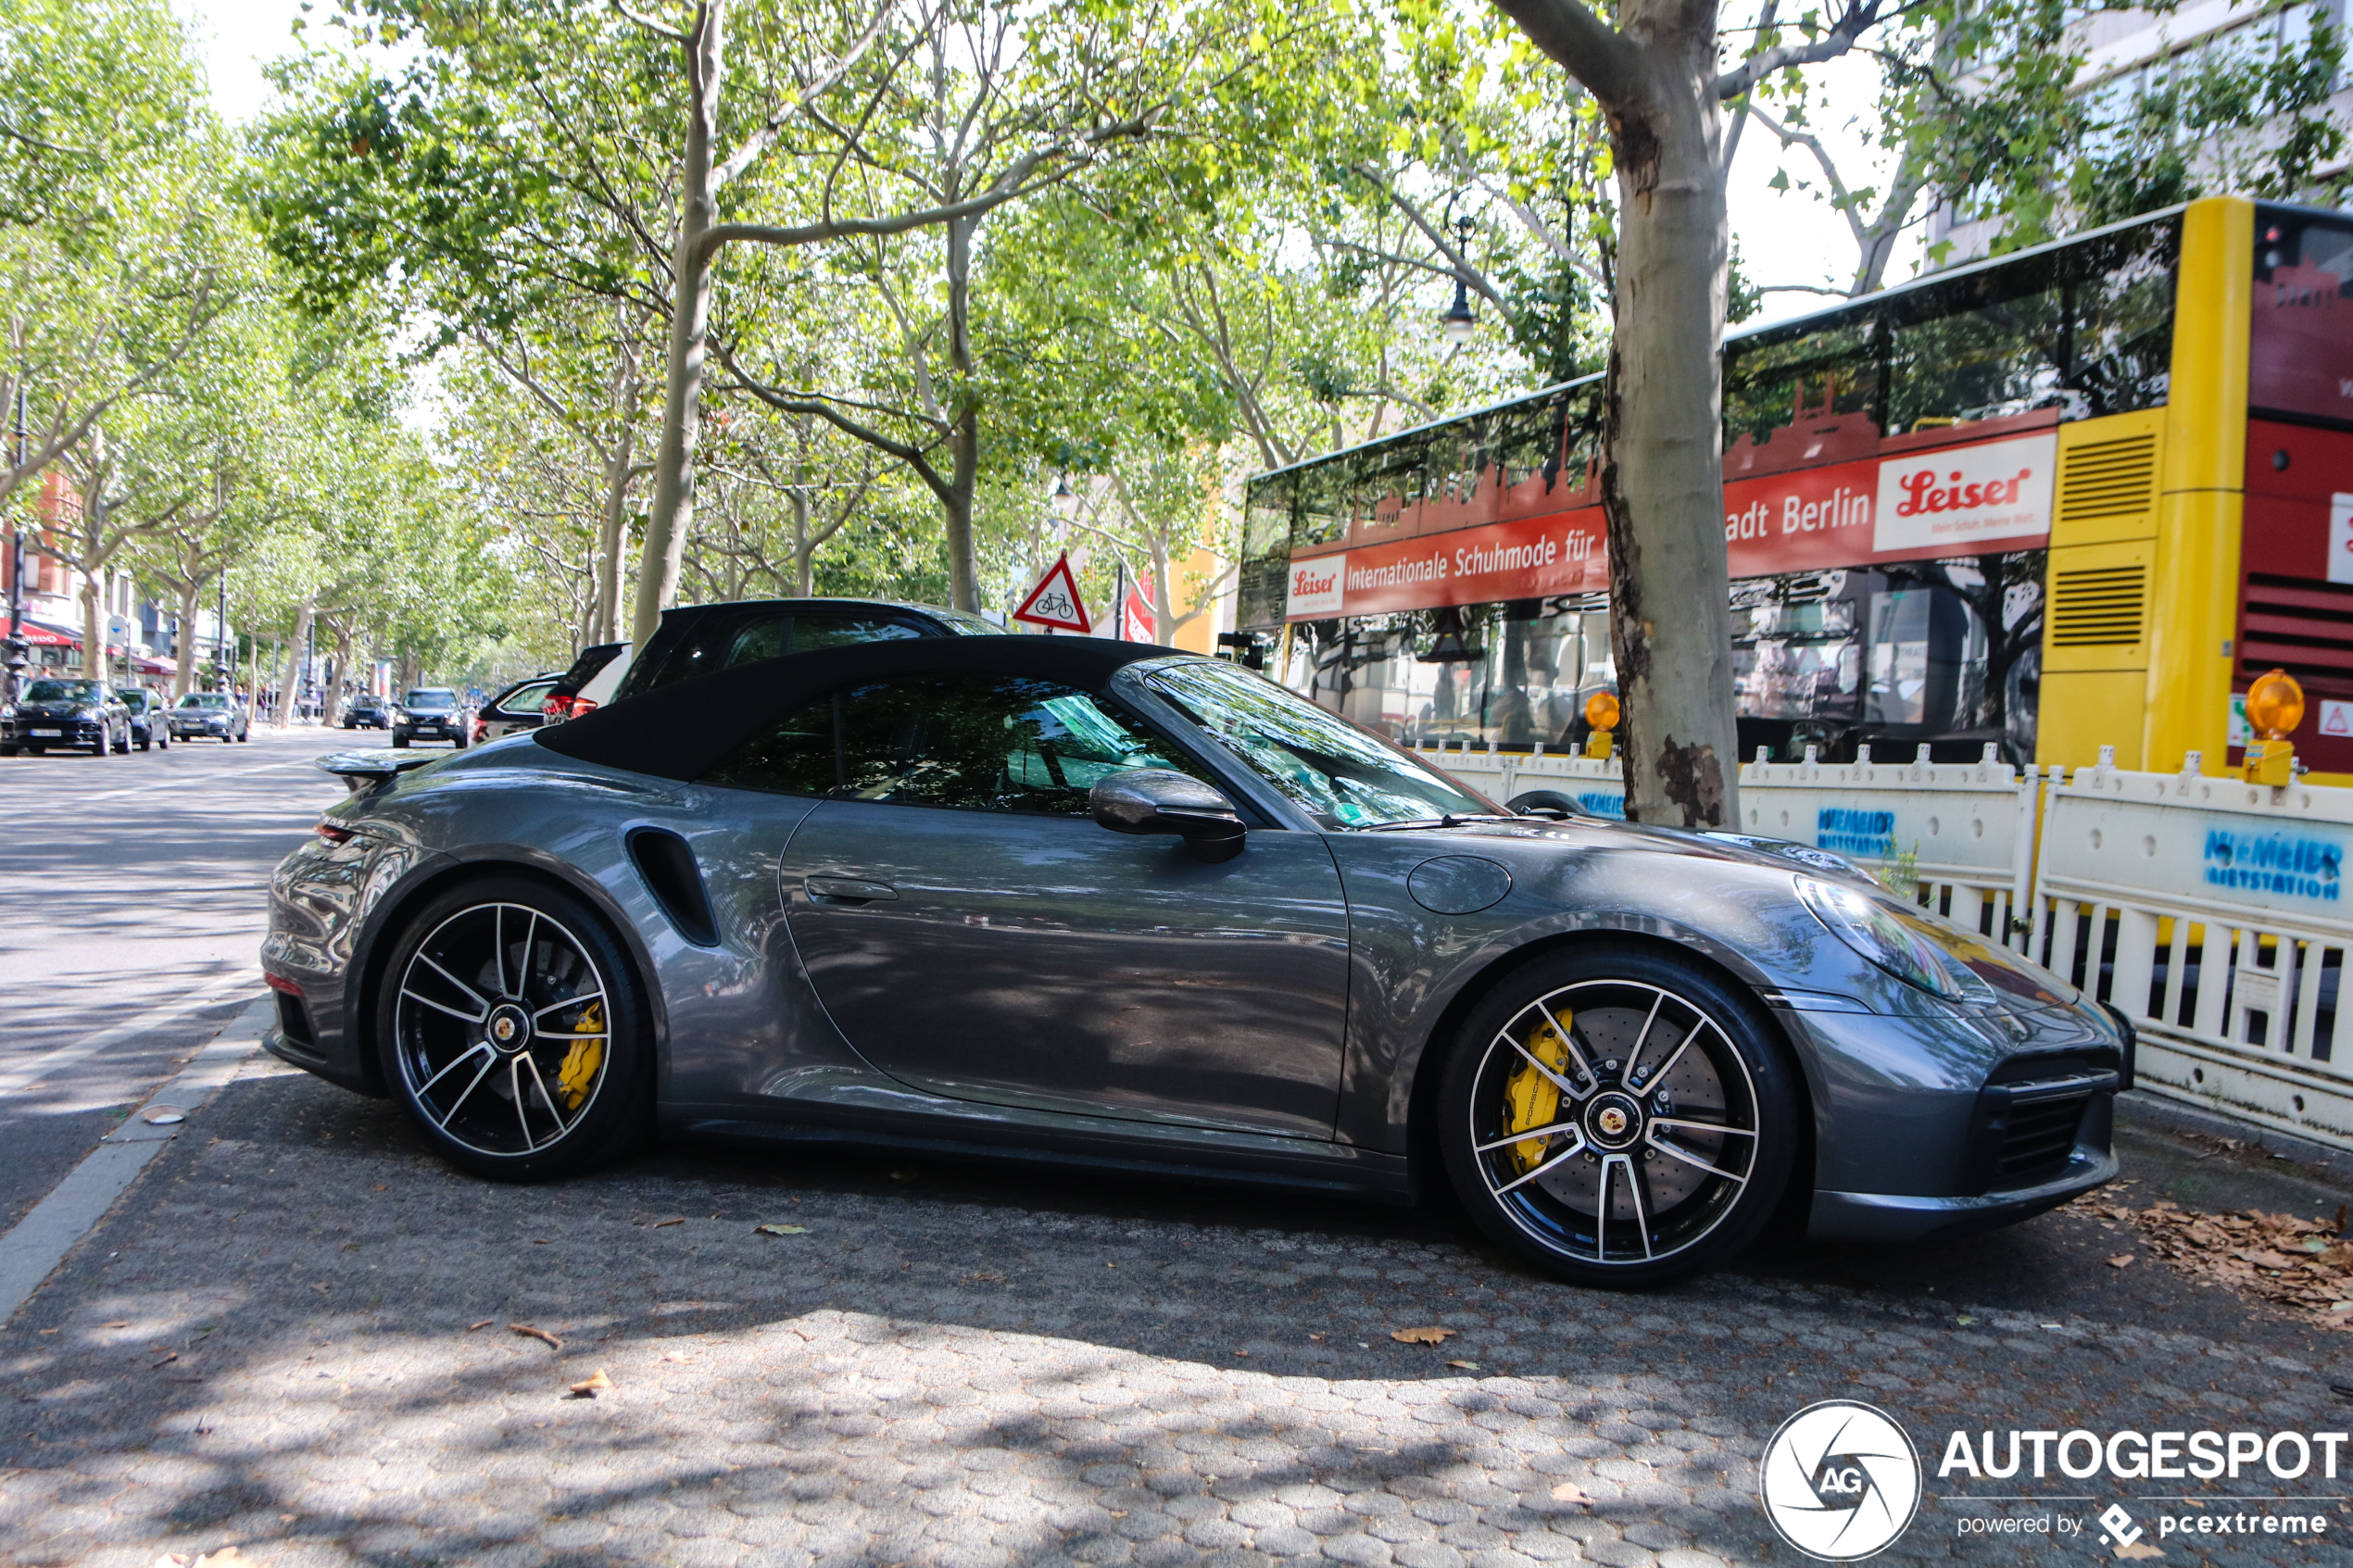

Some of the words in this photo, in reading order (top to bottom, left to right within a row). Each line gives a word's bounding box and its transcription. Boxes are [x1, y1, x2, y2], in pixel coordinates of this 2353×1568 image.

[1896, 468, 2032, 518] Leiser
[1347, 551, 1448, 592] Internationale
[1454, 533, 1556, 577] Schuhmode
[1565, 529, 1596, 563] für
[1725, 500, 1769, 542] adt
[1781, 487, 1869, 535] Berlin
[1293, 570, 1337, 597] Leiser
